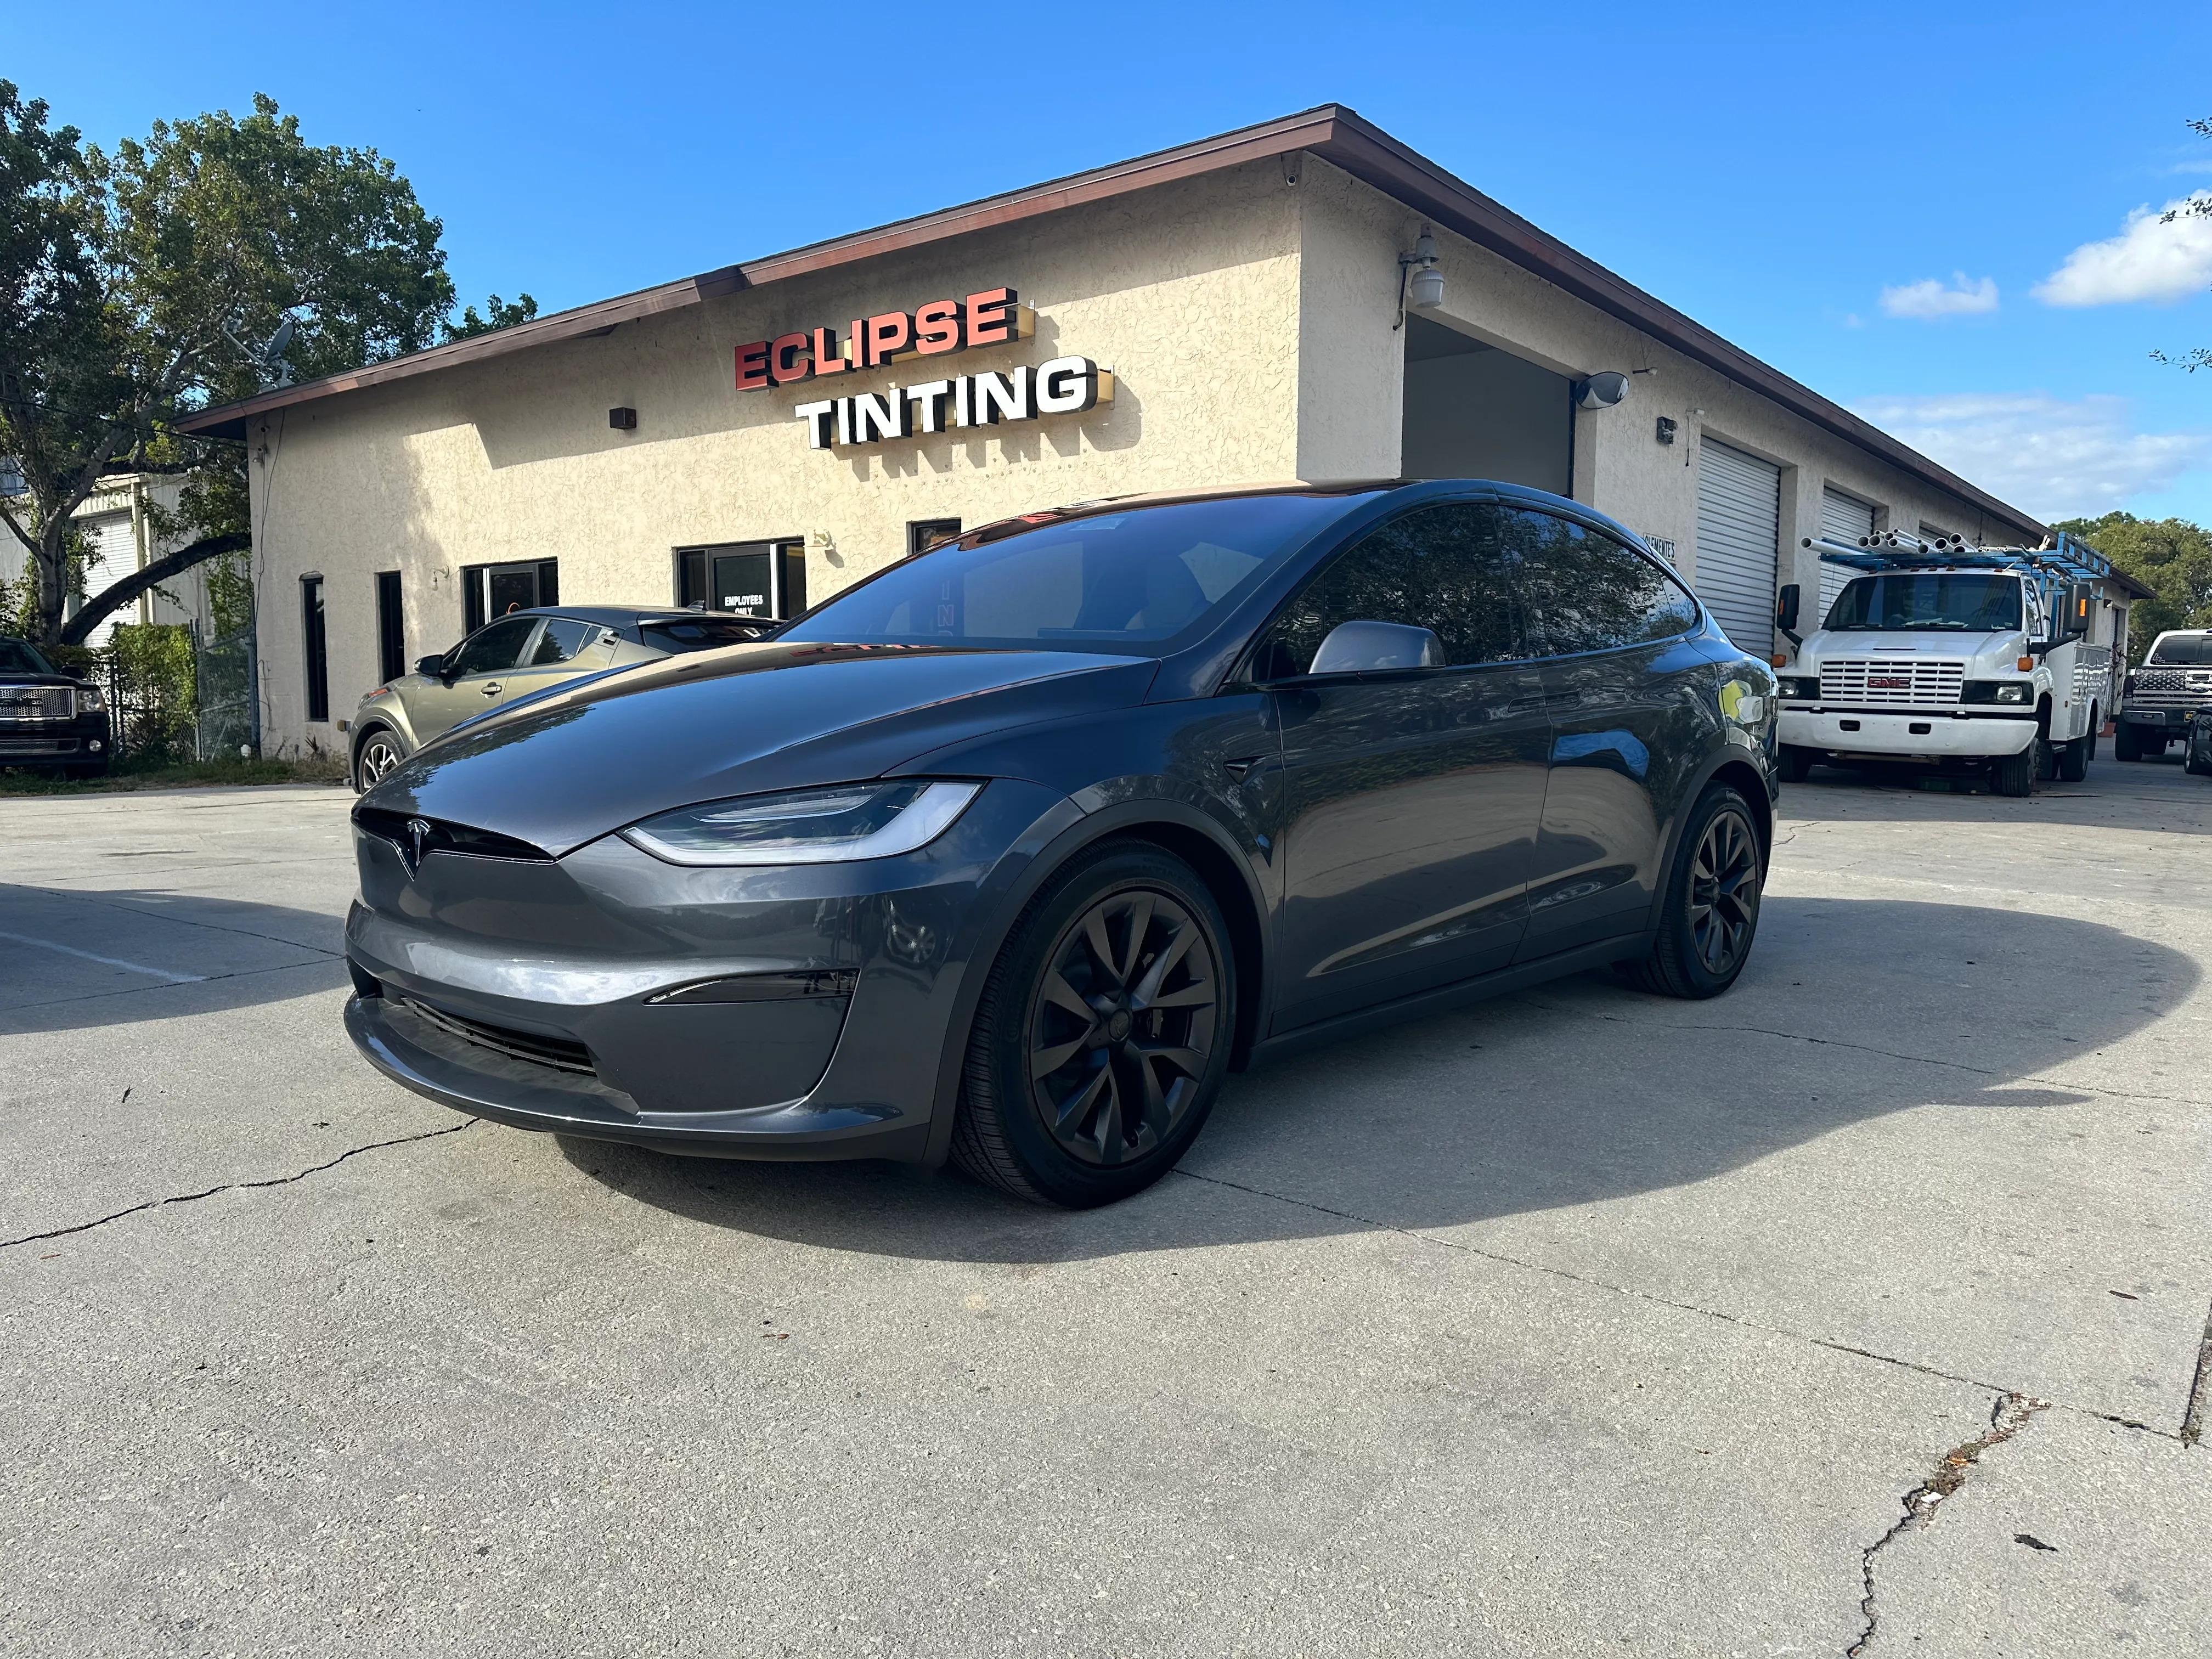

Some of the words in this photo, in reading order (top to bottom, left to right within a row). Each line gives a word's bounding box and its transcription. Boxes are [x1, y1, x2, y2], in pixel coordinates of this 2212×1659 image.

[735, 286, 1013, 393] ECLIPSE
[794, 354, 1092, 450] TINTING
[724, 594, 763, 606] EMPLOYEES
[1867, 678, 1910, 688] GMC
